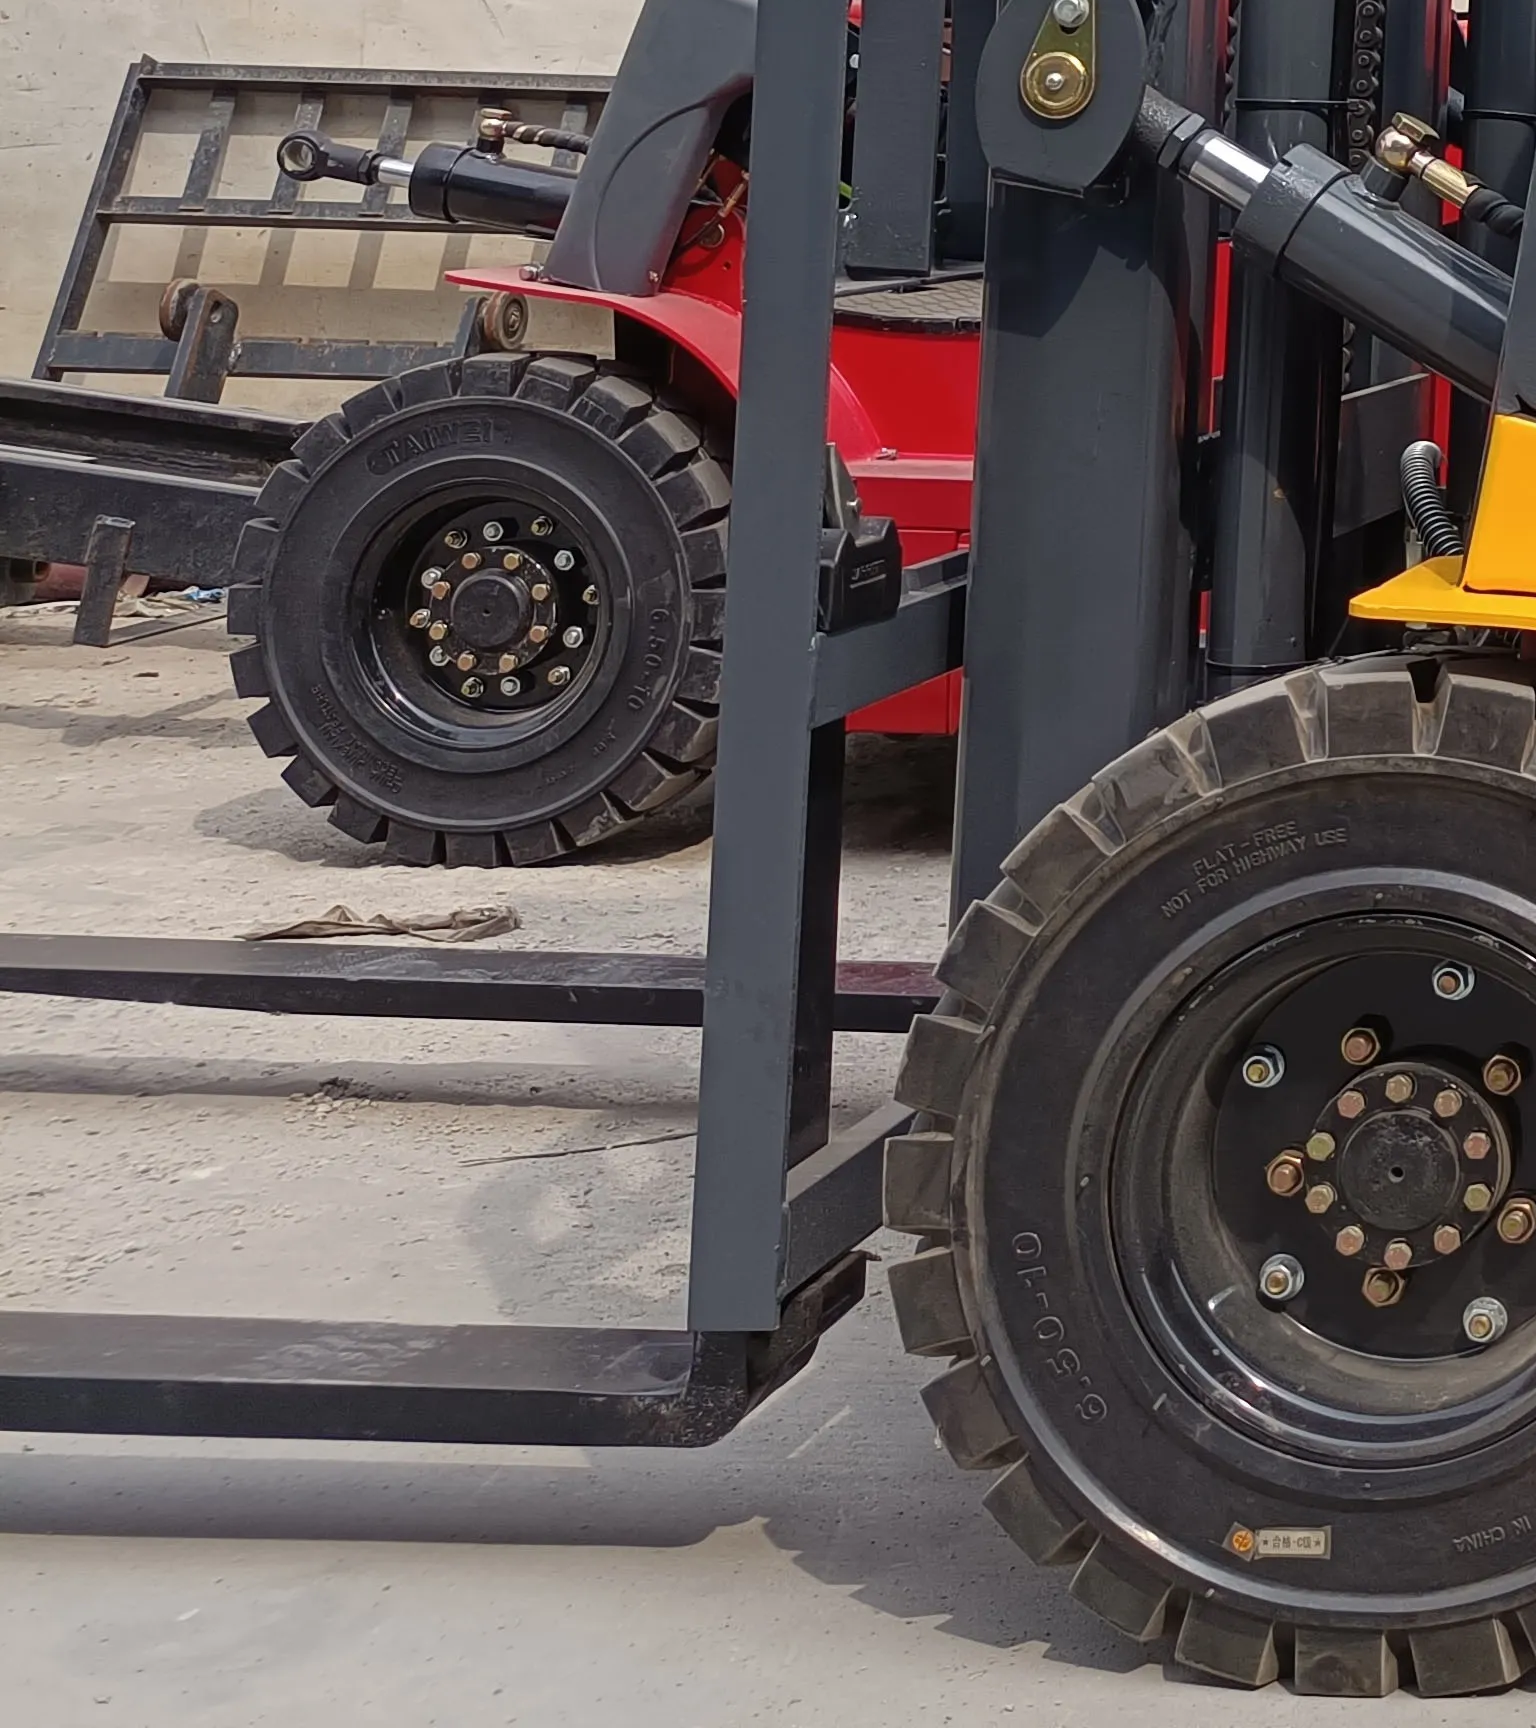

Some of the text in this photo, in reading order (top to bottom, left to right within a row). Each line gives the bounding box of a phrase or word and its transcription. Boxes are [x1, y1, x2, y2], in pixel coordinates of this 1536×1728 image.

[1160, 827, 1348, 919] NOT FOR HIGHWAY USE
[1012, 1231, 1108, 1422] 6.50-10
[1452, 1525, 1507, 1553] CHINA
